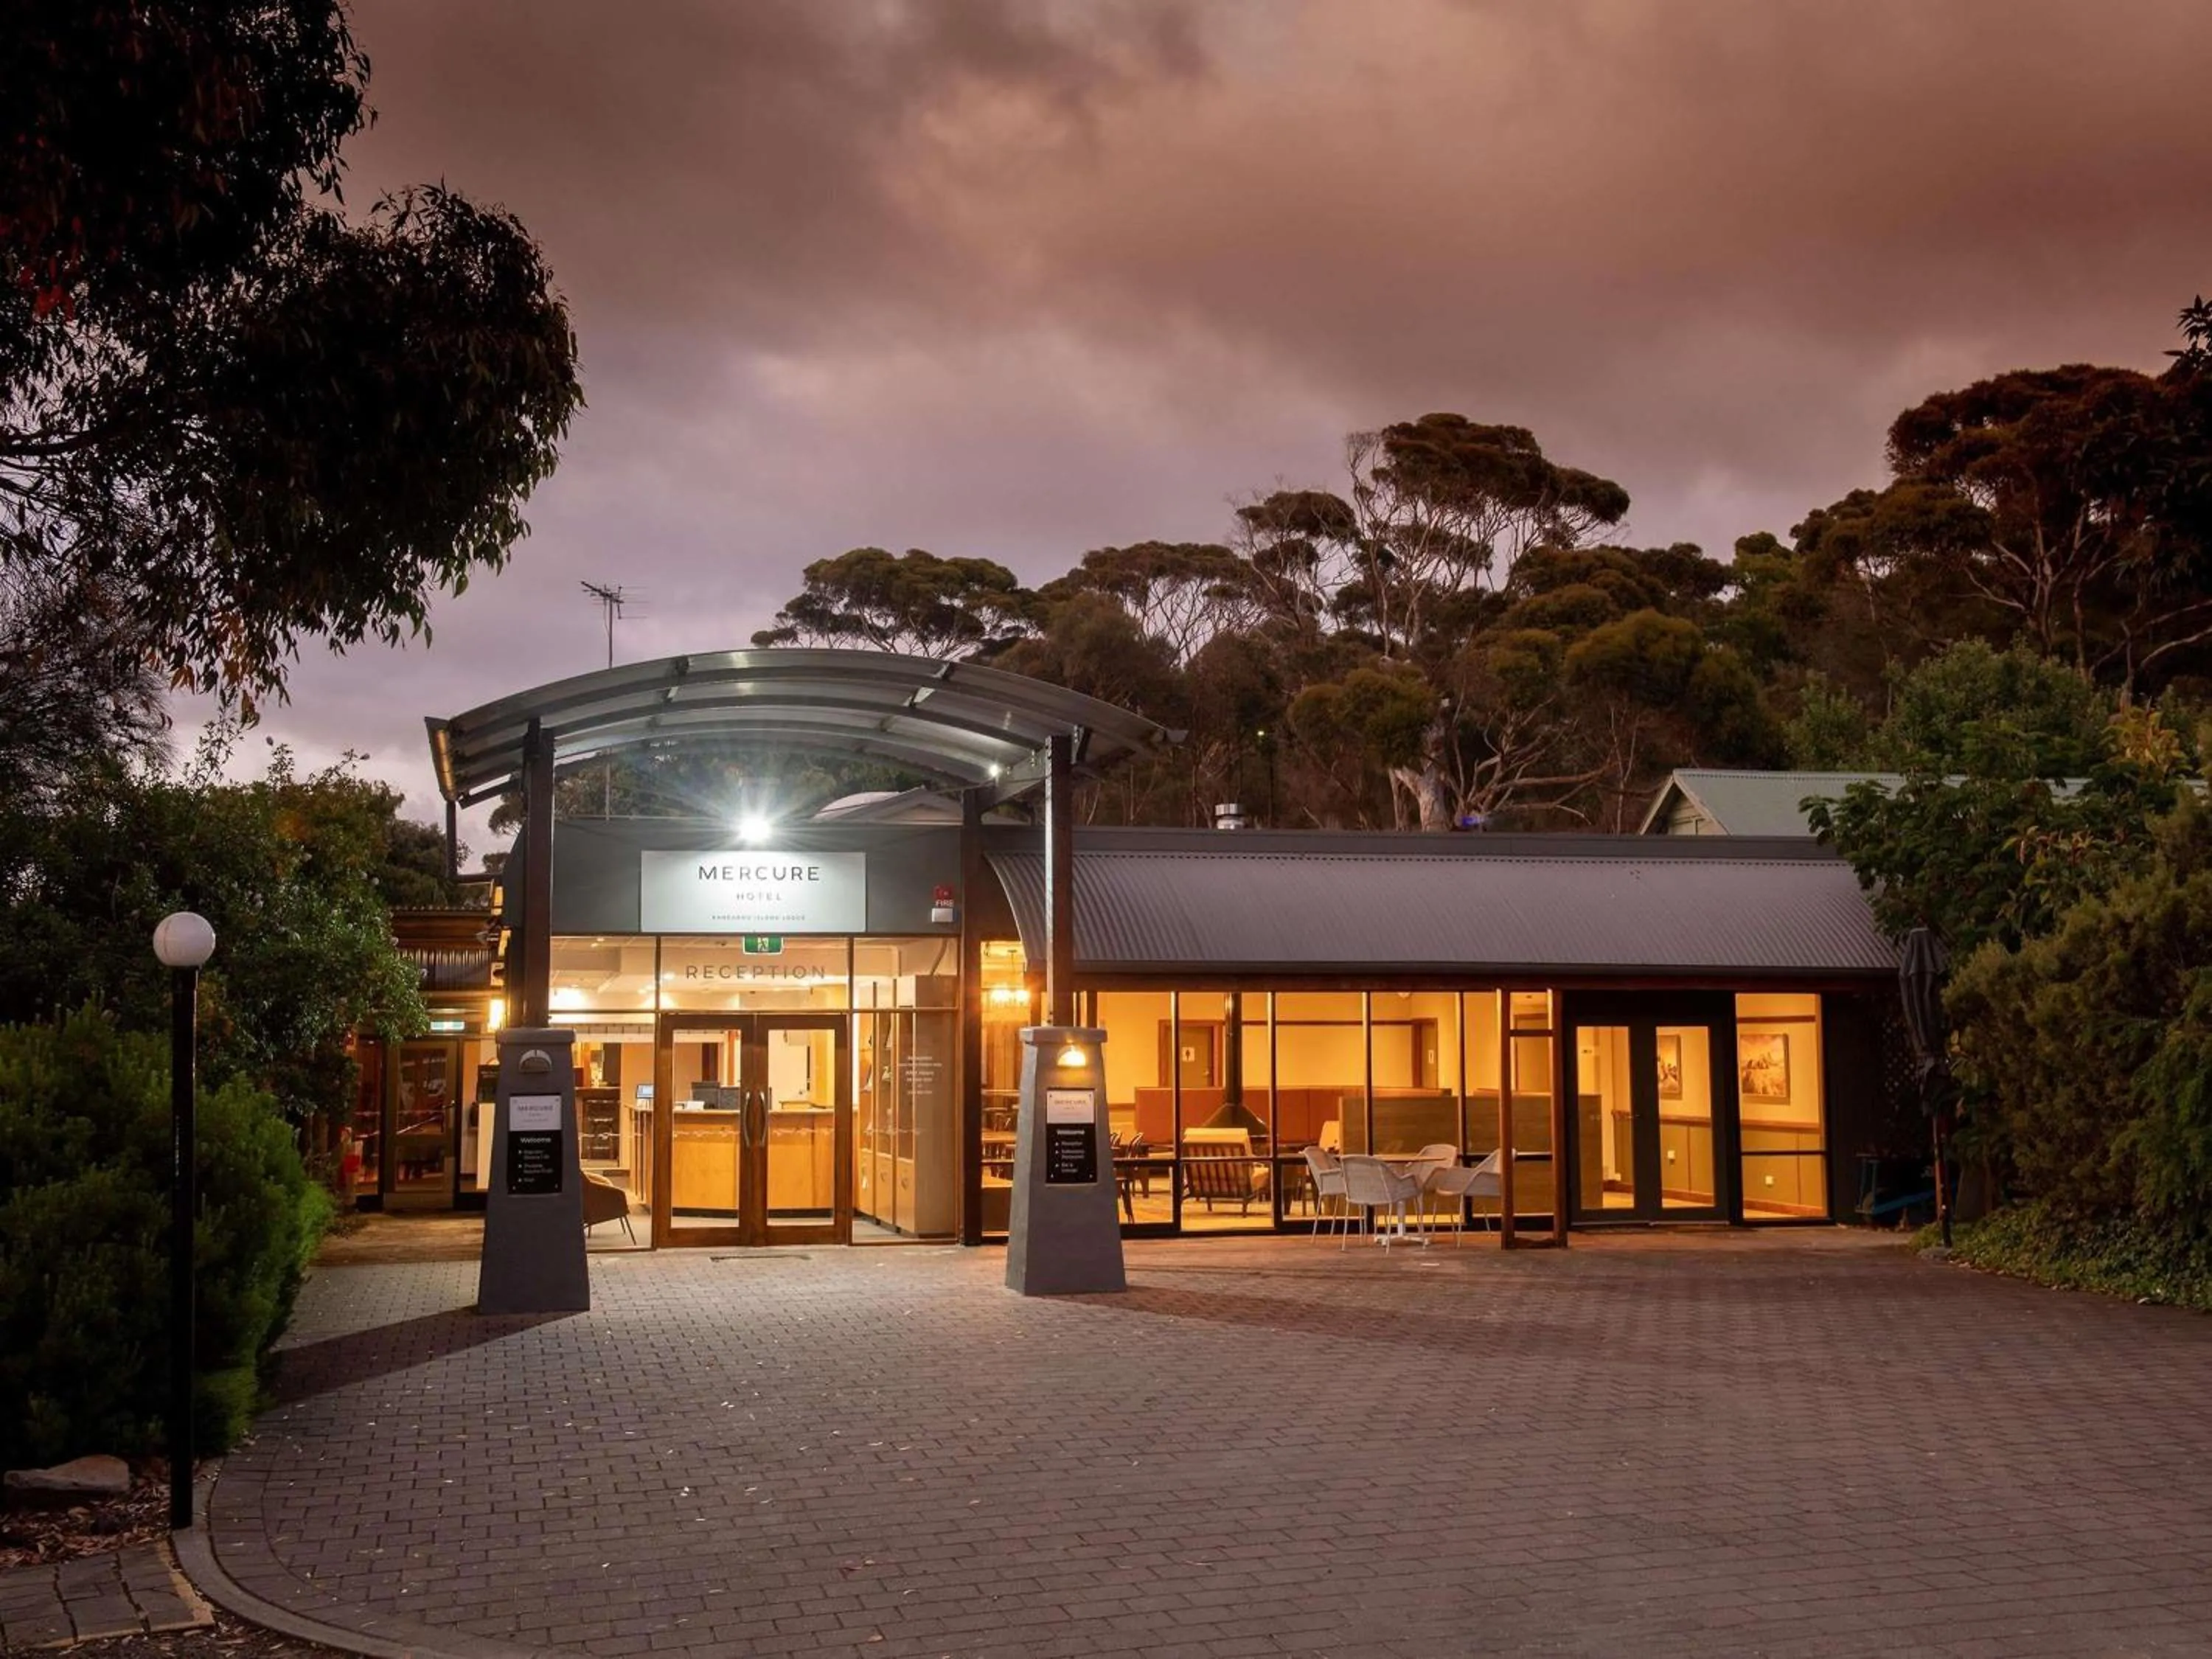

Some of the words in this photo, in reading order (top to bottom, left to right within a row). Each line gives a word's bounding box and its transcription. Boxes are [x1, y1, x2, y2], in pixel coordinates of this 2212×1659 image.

[698, 866, 820, 881] MERCURE
[736, 892, 782, 901] HOTEL
[936, 900, 954, 908] FIRE
[686, 964, 826, 980] RECEPTION
